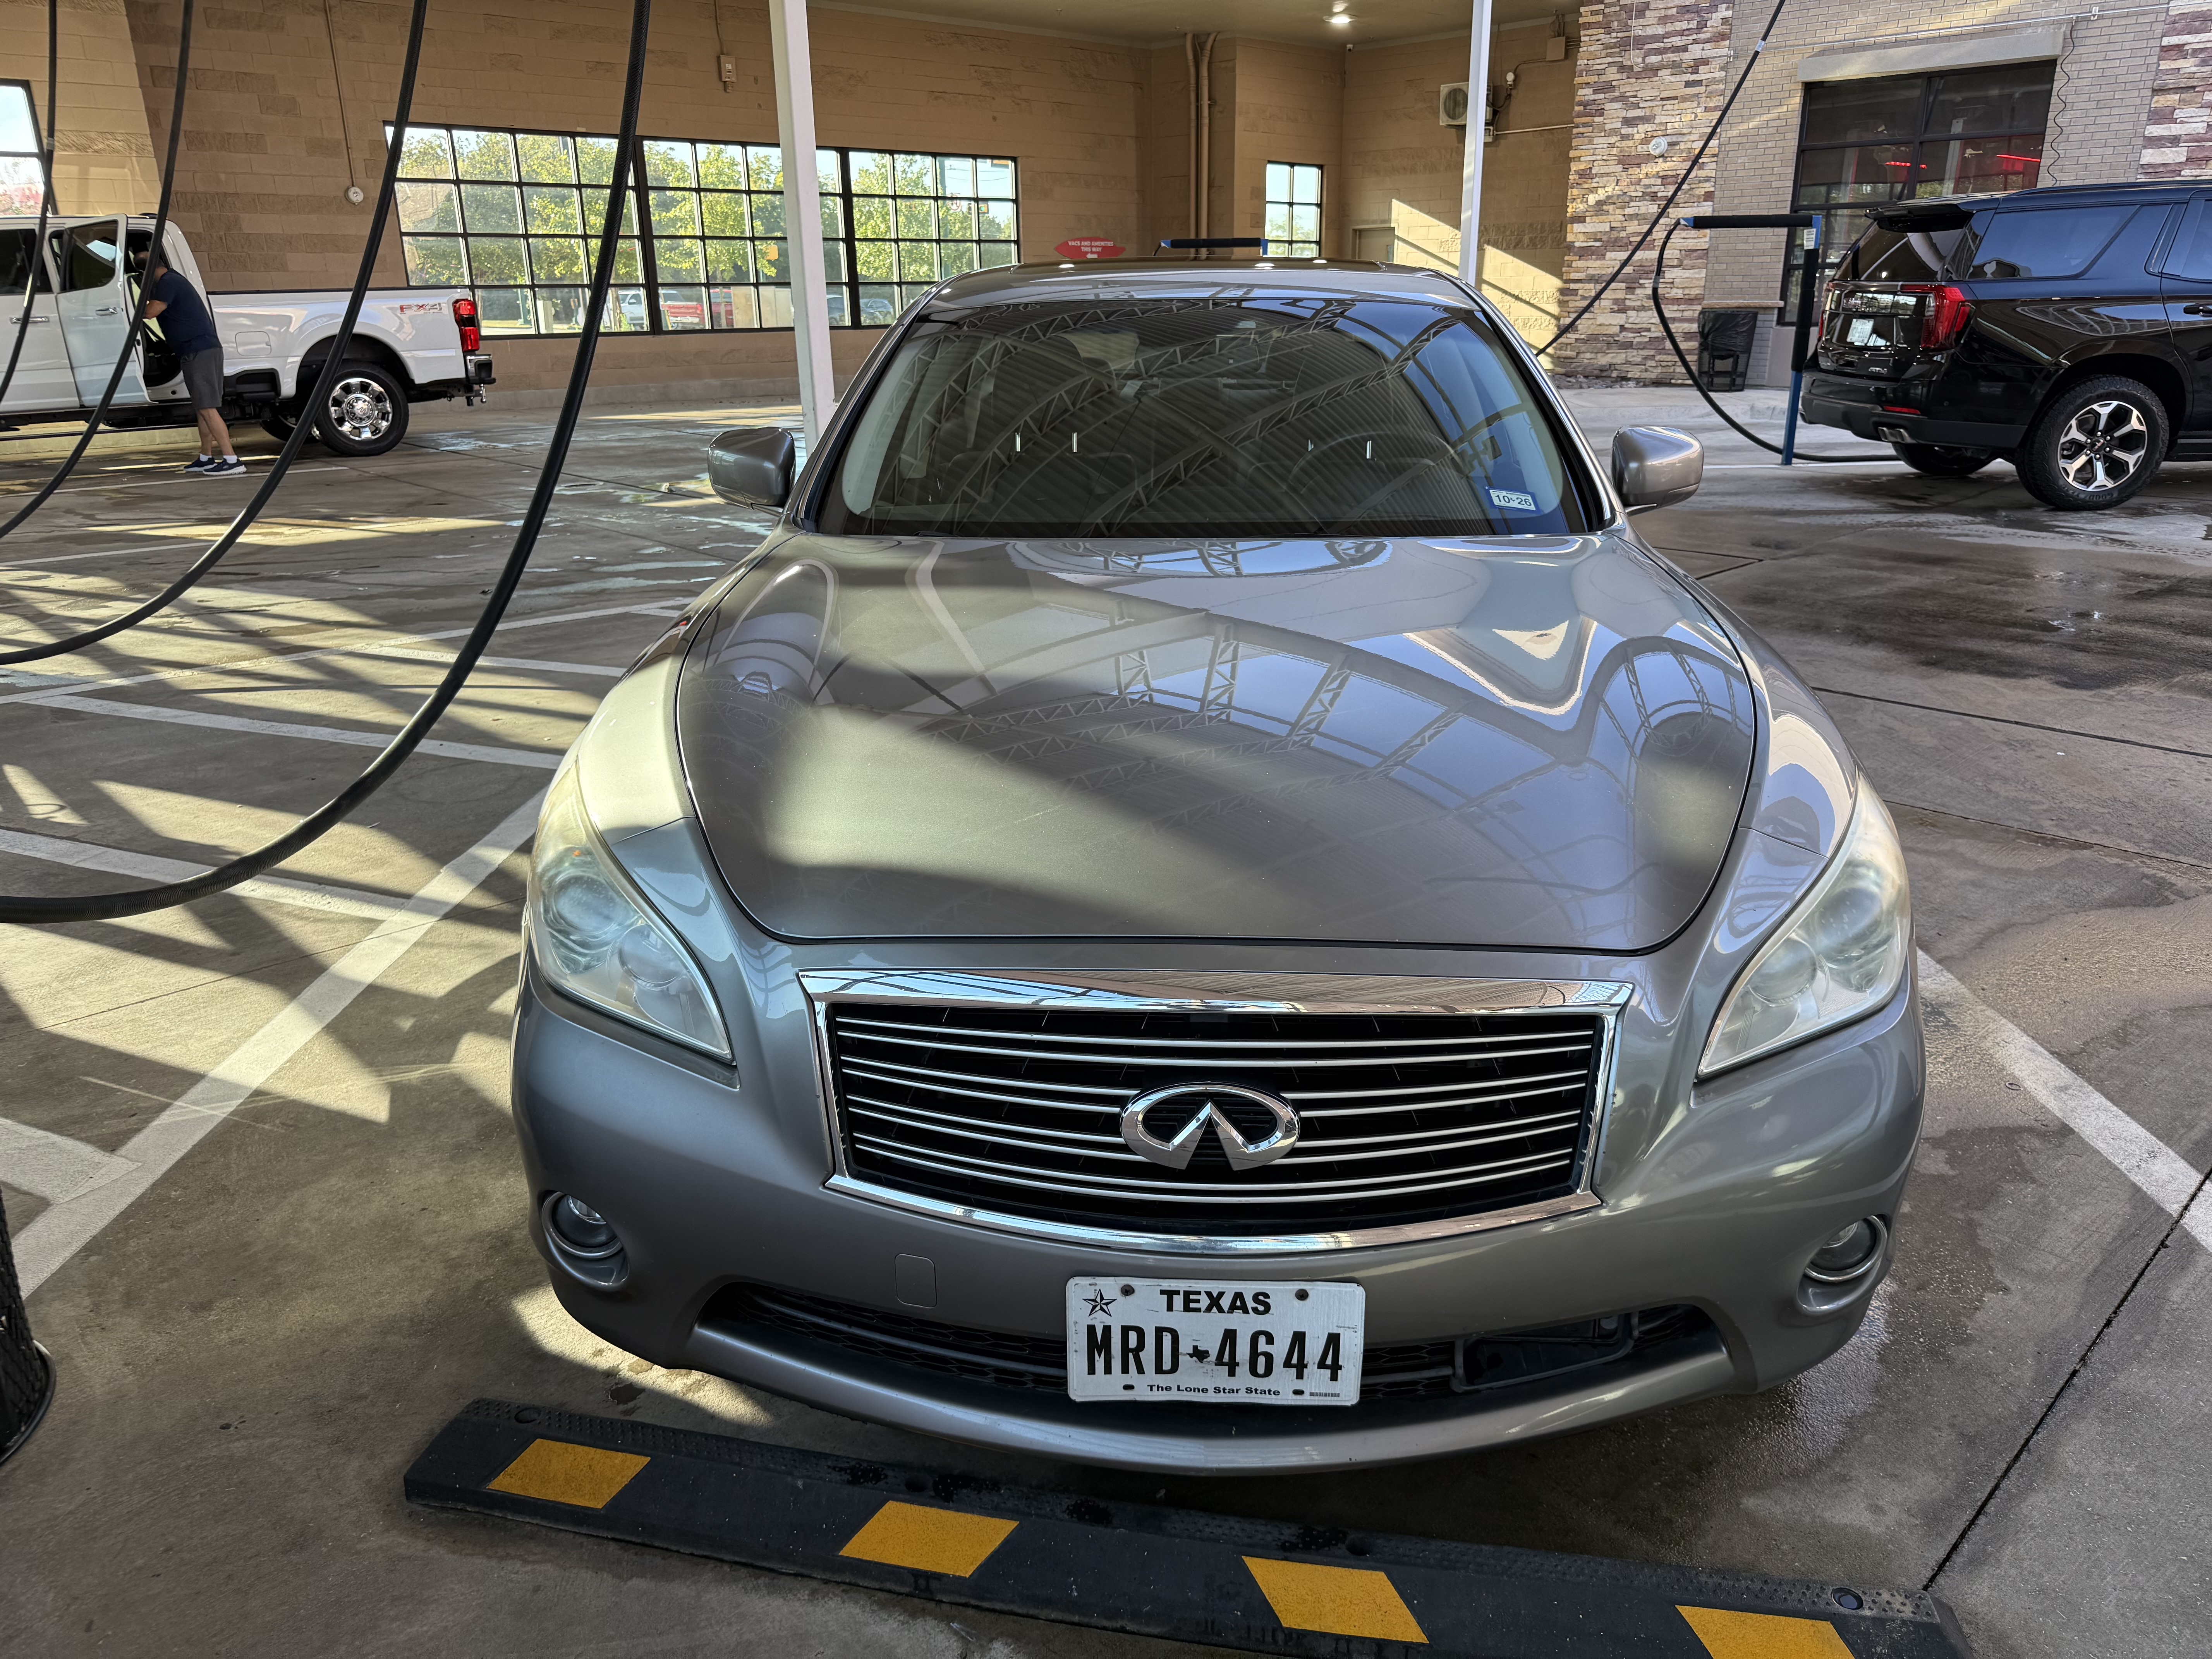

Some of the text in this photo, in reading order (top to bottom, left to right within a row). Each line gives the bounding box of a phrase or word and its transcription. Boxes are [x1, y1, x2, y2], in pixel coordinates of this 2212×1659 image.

[400, 303, 442, 314] FX4
[1159, 1289, 1271, 1315] TEXAS
[1177, 1384, 1209, 1393] Lone
[1245, 1387, 1281, 1396] State
